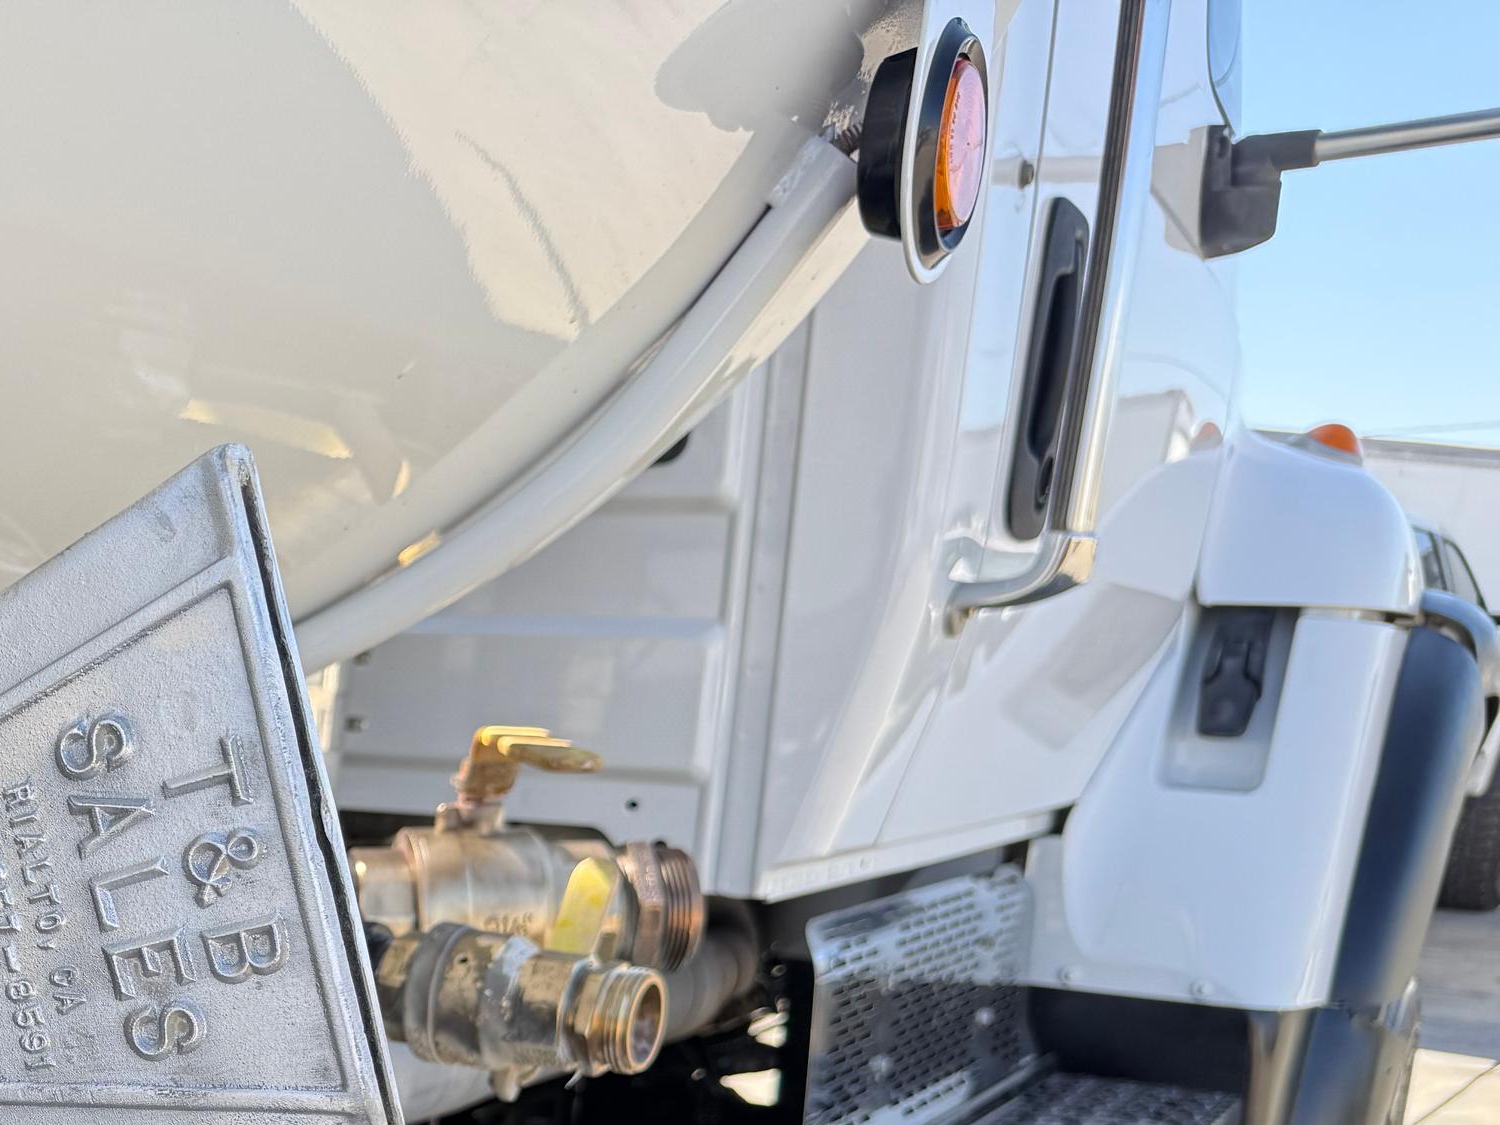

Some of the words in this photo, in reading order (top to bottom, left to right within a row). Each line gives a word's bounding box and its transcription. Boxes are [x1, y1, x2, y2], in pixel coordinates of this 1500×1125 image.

[3, 777, 67, 950] RIALTO,
[50, 963, 88, 1017] CA
[56, 710, 206, 1061] SALES
